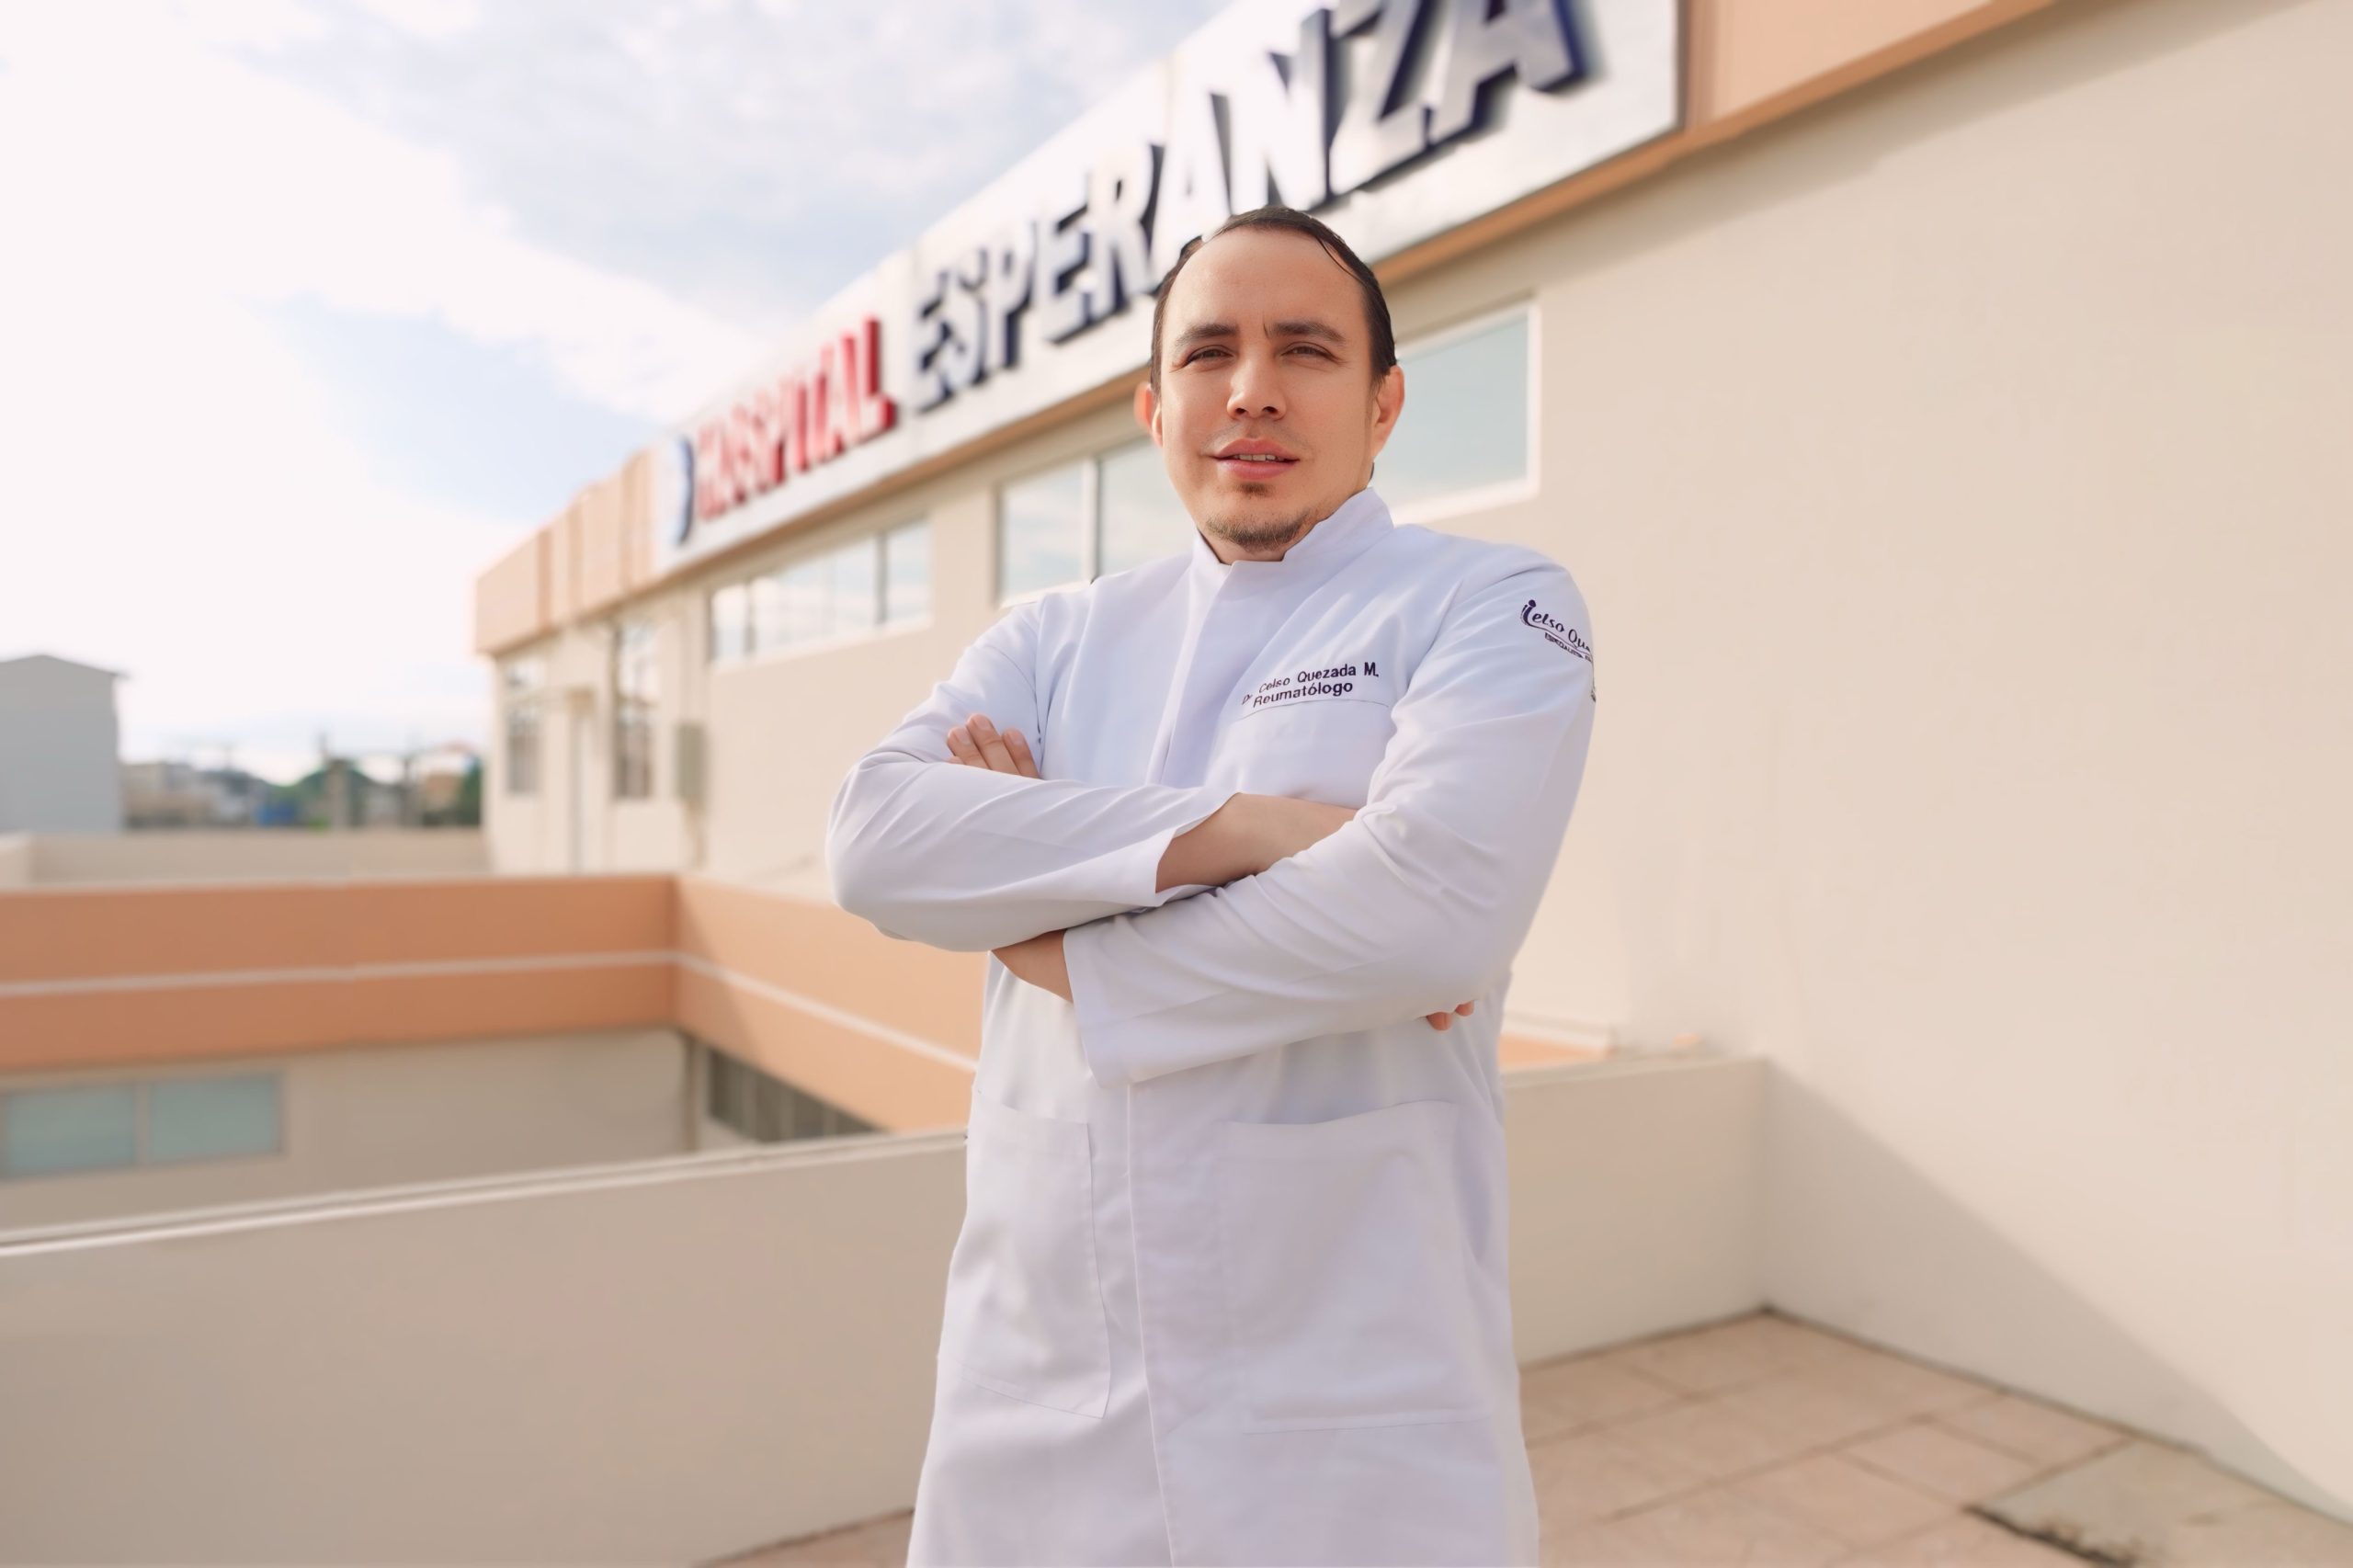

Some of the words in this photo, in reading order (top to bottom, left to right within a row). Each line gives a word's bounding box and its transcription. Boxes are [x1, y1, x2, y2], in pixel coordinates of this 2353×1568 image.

[695, 311, 897, 521] HOSPITAL
[913, 0, 1590, 412] ESPERANZA
[1258, 677, 1290, 694] Celso
[1297, 664, 1358, 684] Quezada
[1364, 662, 1380, 677] M.
[1253, 681, 1354, 709] Reumatólogo
